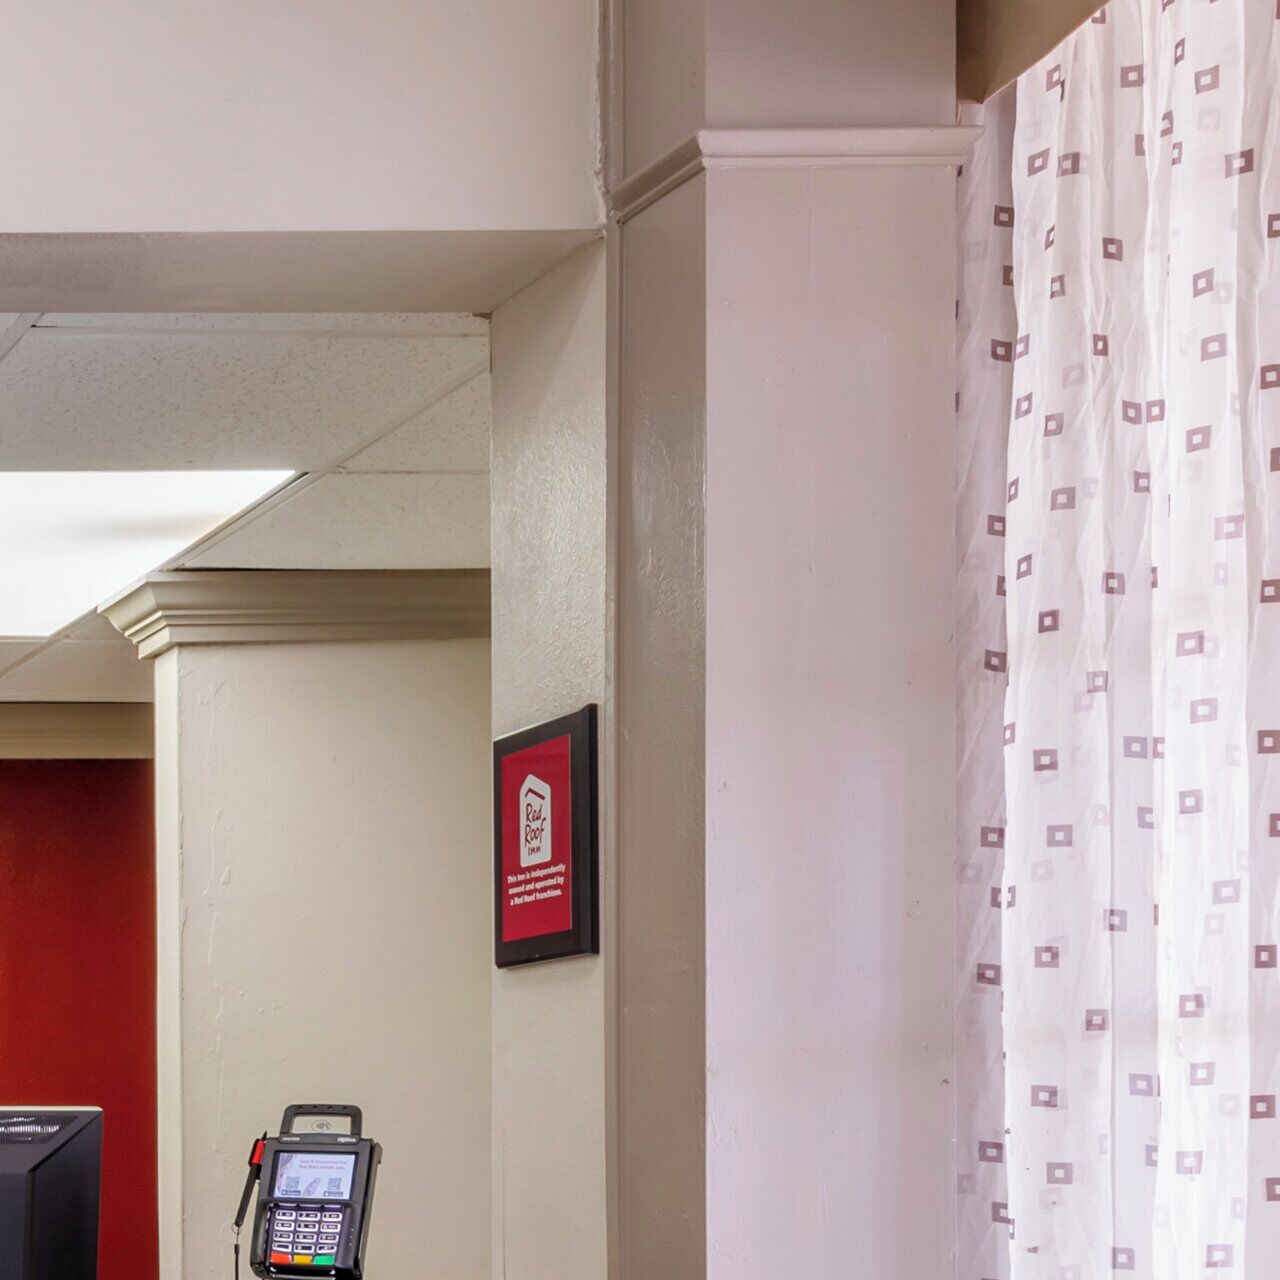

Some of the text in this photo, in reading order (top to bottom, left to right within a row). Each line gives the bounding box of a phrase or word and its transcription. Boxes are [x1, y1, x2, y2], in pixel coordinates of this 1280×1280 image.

[526, 803, 543, 823] Red
[525, 817, 547, 847] Roof
[507, 875, 517, 884] This
[530, 863, 566, 878] independently
[508, 875, 565, 895] owned and operated by
[514, 895, 524, 905] Red
[524, 892, 536, 903] Roof
